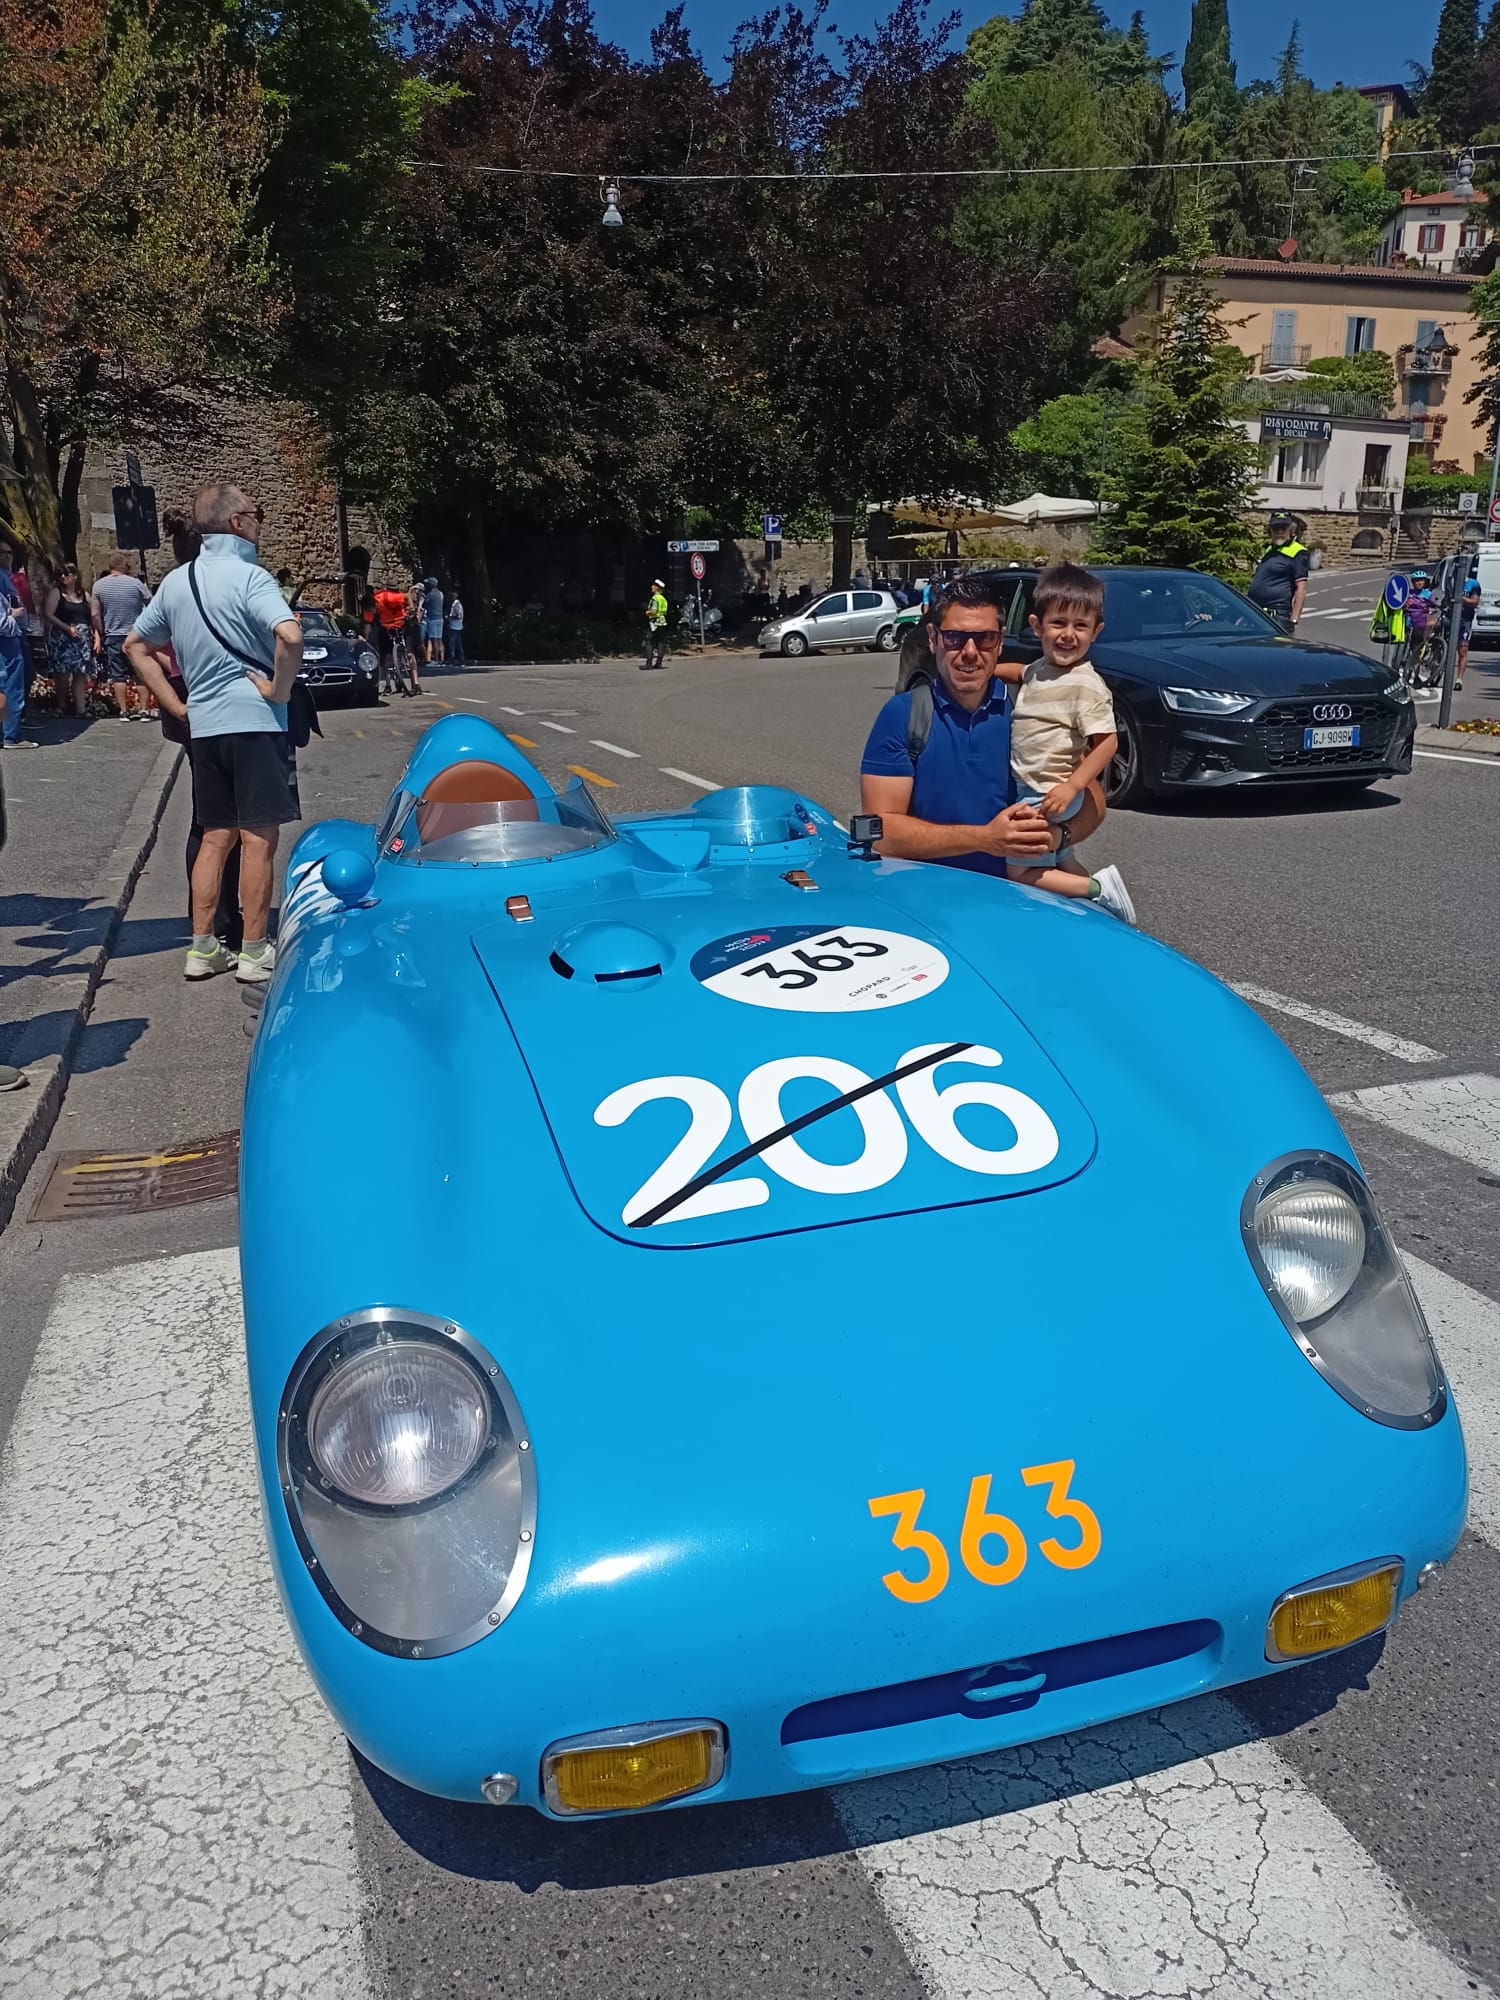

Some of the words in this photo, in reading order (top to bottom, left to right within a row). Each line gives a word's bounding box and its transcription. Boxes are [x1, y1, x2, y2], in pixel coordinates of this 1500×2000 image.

[1265, 417, 1319, 431] RISTORANTE
[741, 936, 888, 989] 363
[848, 976, 890, 997] CHOPARD
[593, 1042, 1060, 1228] 206
[868, 1459, 1102, 1603] 363
